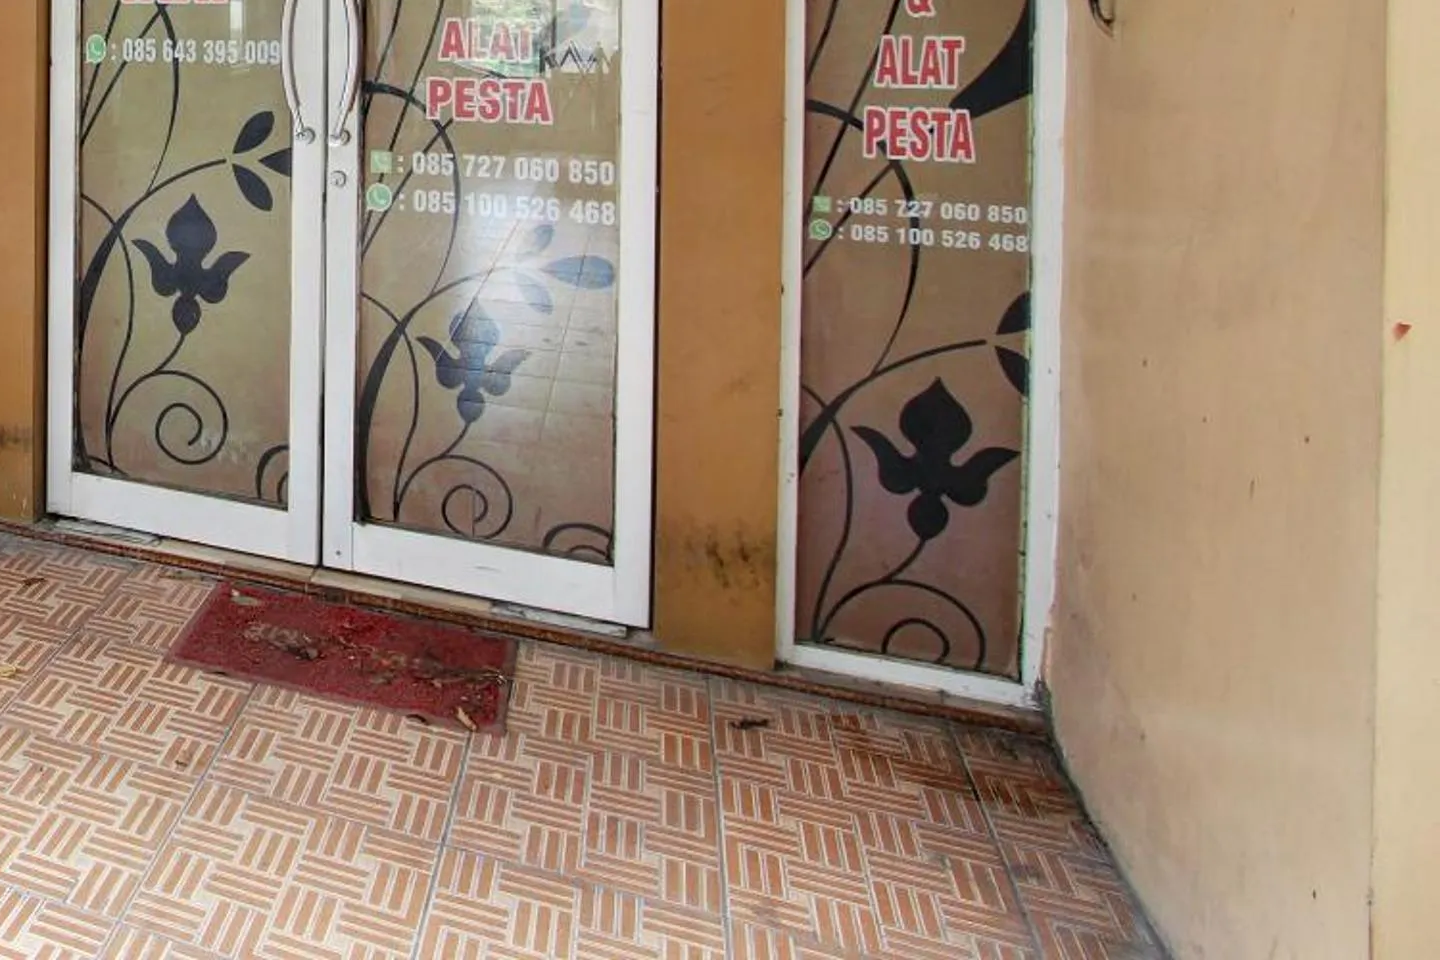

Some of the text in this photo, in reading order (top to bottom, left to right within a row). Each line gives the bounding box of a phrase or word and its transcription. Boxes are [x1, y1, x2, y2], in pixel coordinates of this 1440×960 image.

[122, 38, 157, 62] 085
[162, 39, 197, 63] 643
[203, 40, 238, 64] 395
[244, 40, 281, 65] 009
[874, 34, 964, 89] ALAT
[426, 77, 553, 124] PESTA
[863, 105, 976, 163] PESTA
[412, 151, 455, 176] 085
[462, 154, 506, 179] 727
[514, 156, 559, 182] 060
[568, 160, 614, 186] 850
[413, 189, 456, 214] 085
[464, 192, 508, 218] 100
[515, 196, 560, 222] 526
[568, 200, 616, 226] 468
[849, 197, 888, 216] 085
[894, 199, 934, 218] 727
[940, 202, 980, 222] 060
[987, 205, 1028, 225] 850
[850, 225, 889, 243] 085
[896, 228, 934, 246] 100
[941, 231, 981, 250] 526
[987, 234, 1029, 253] 468
